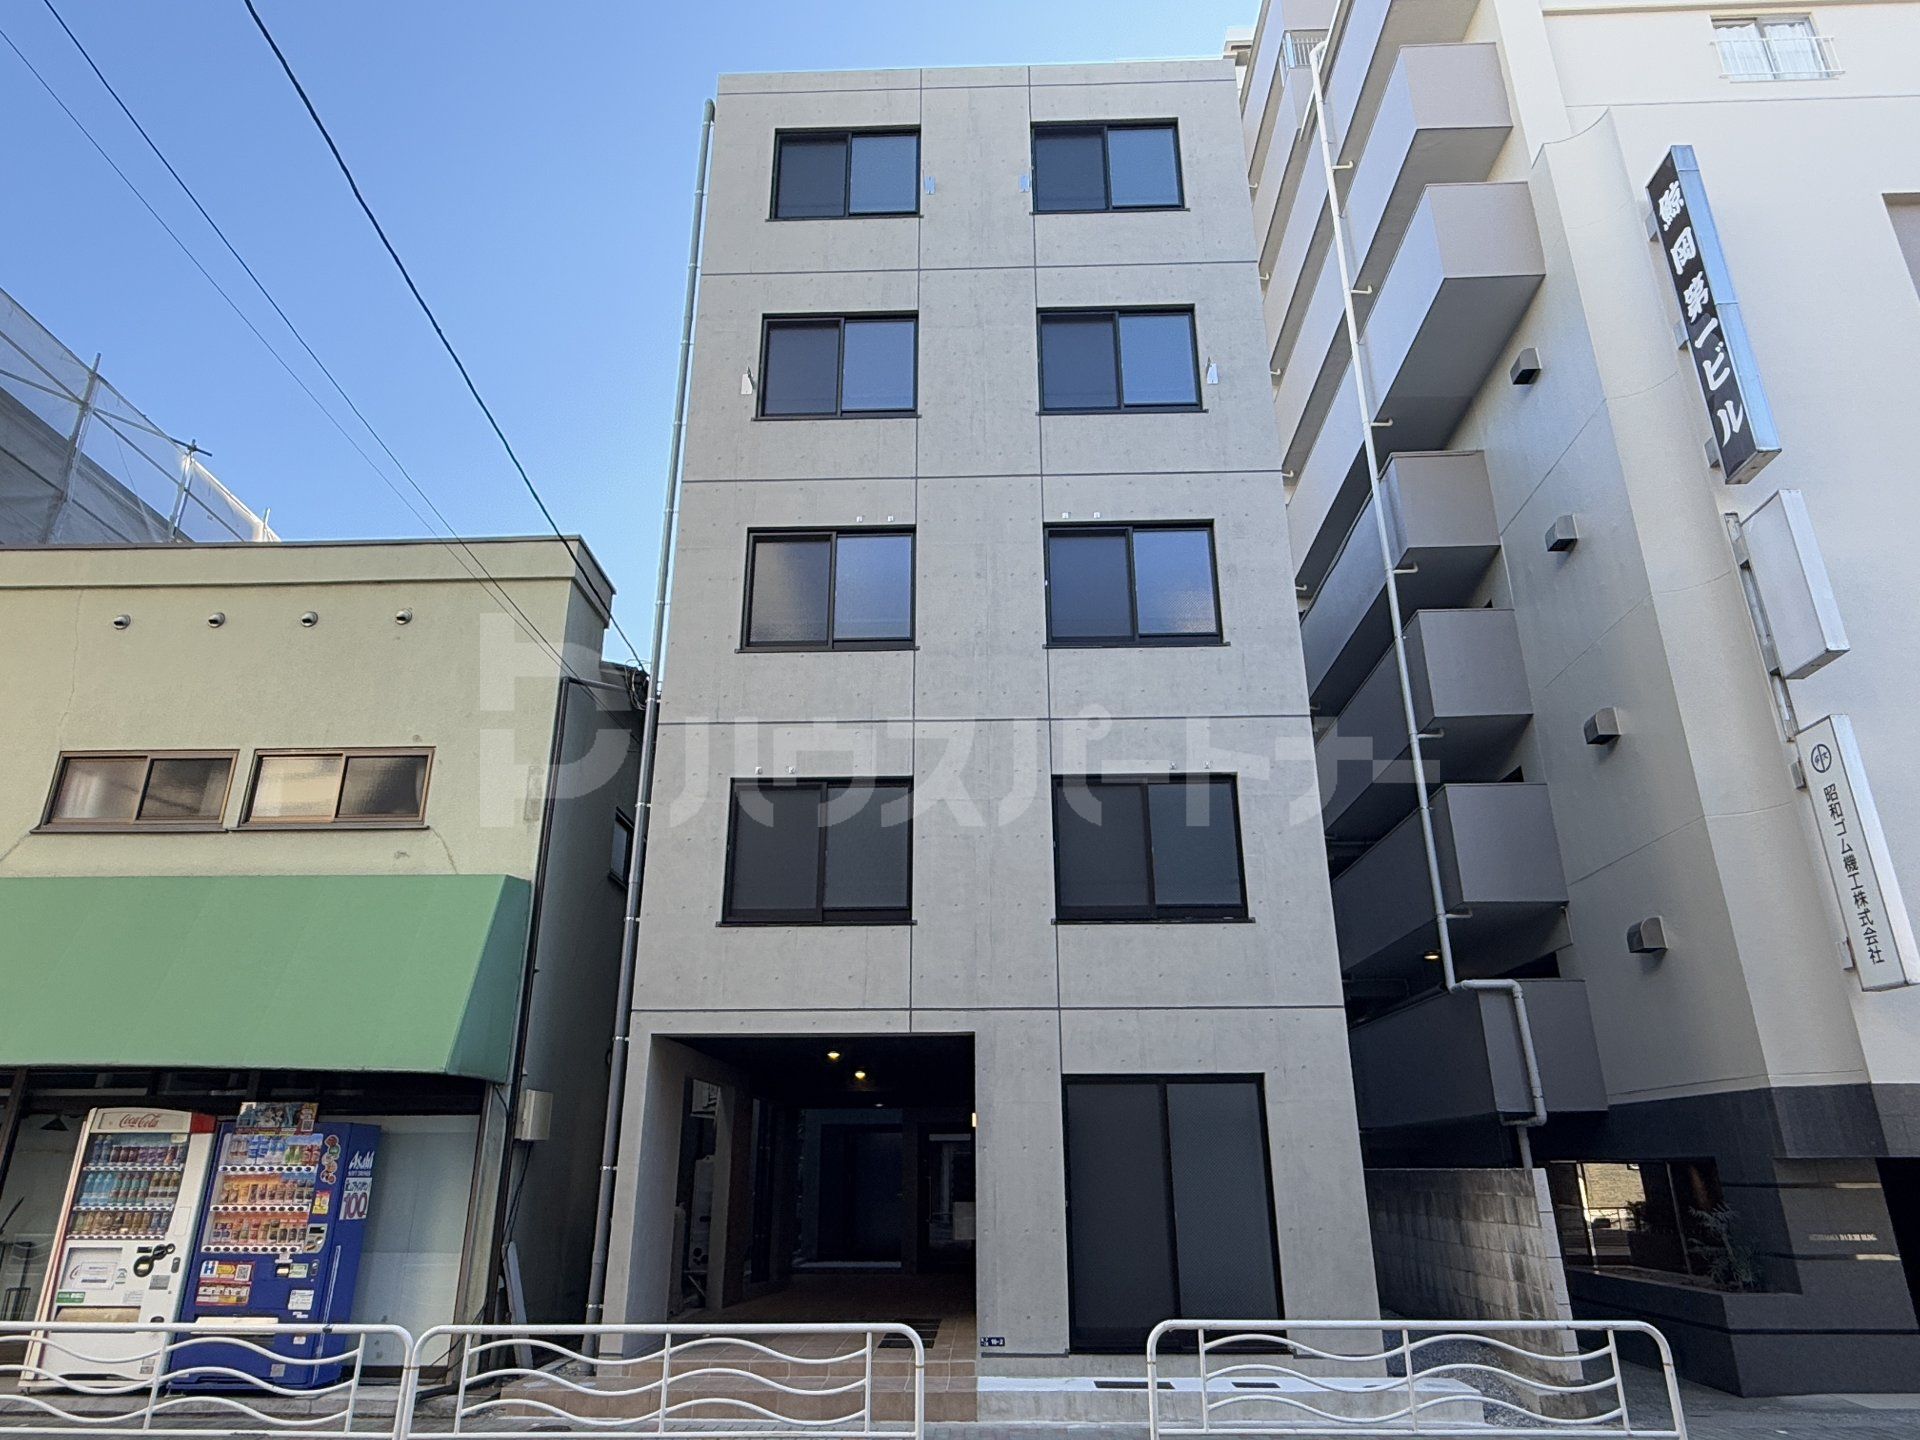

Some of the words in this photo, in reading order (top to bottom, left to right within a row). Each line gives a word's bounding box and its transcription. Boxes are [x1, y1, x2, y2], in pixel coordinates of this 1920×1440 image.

[1823, 783, 1885, 965] 昭和ゴム機工株式会社
[349, 1150, 374, 1169] Asahi
[343, 1192, 367, 1219] 100
